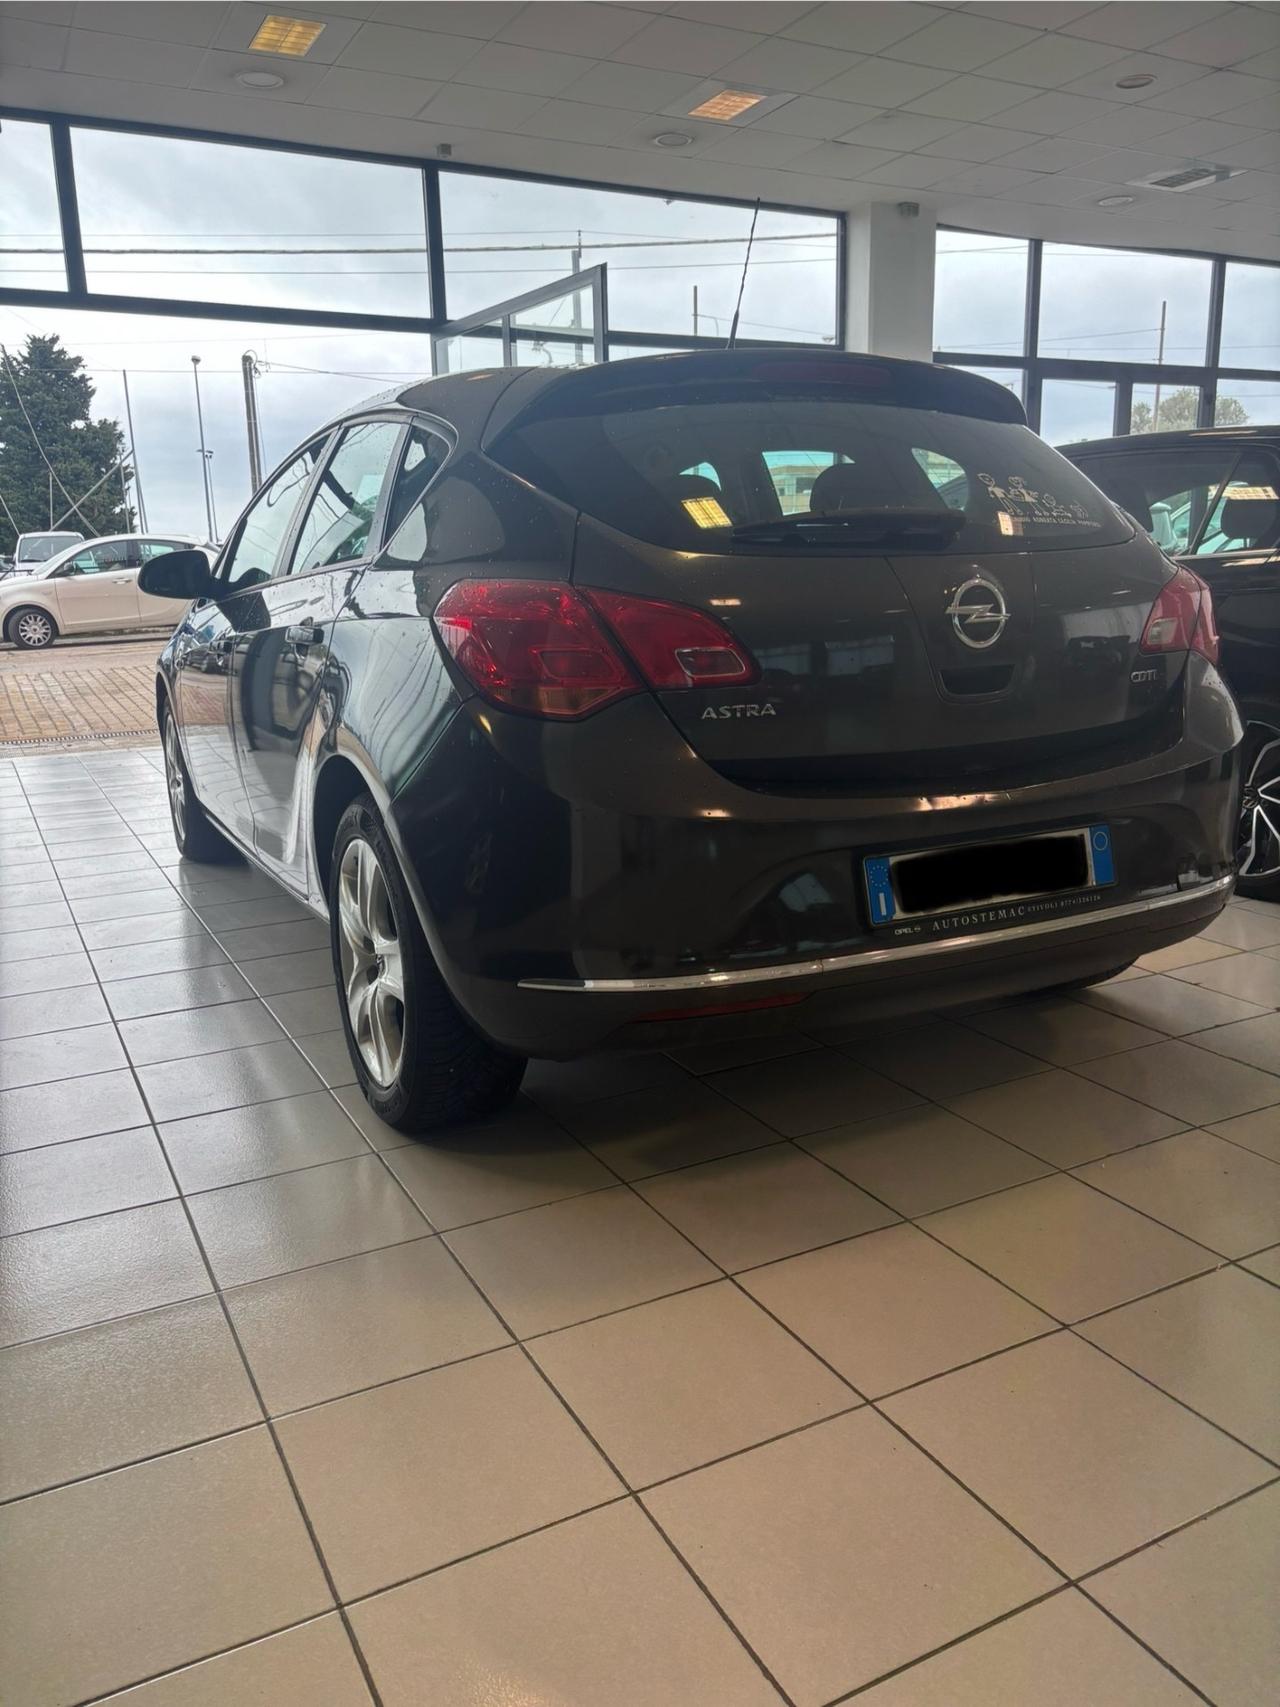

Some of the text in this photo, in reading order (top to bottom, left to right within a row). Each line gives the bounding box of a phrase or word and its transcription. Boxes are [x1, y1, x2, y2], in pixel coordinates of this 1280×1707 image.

[701, 703, 777, 720] ASTRA
[894, 926, 915, 936] OPEL
[932, 905, 1026, 931] AUTOSTEMAC
